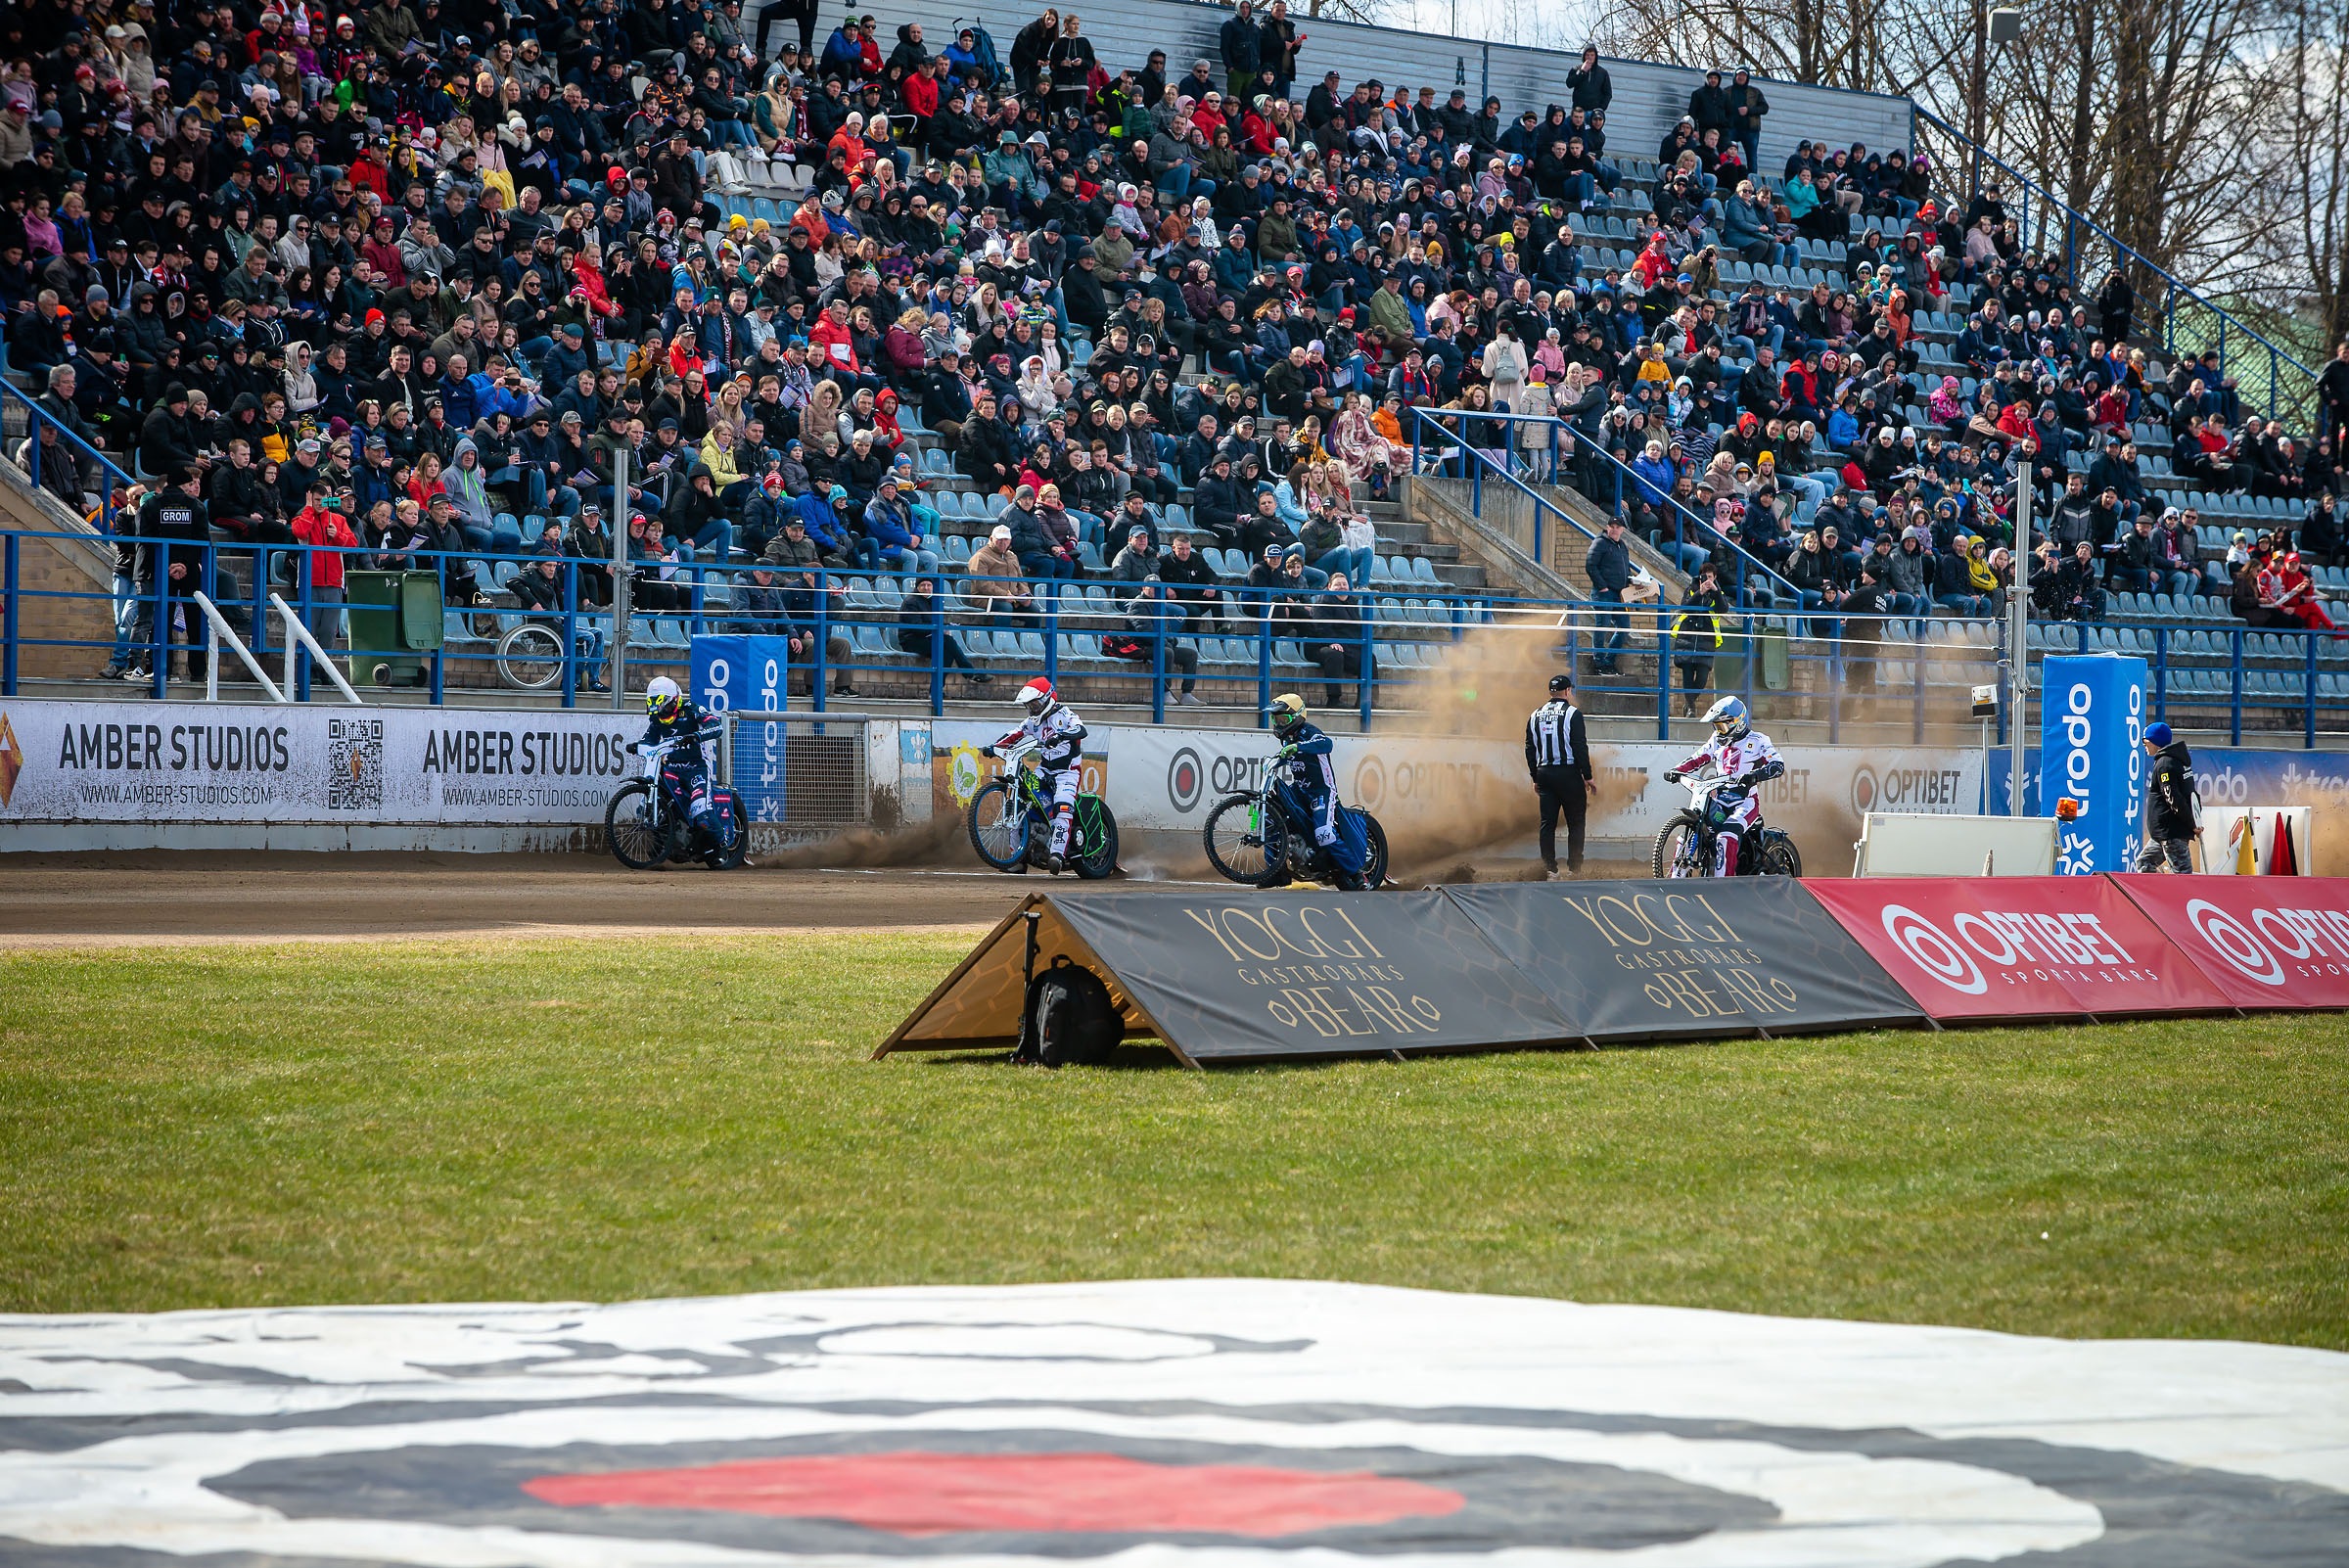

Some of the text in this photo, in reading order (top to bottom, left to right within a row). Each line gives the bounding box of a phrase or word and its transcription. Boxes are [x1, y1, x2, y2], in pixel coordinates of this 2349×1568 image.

[162, 511, 190, 522] GROM
[59, 723, 289, 772] AMBER STUDIOS
[422, 729, 625, 776] AMBER STUDIOS
[2125, 684, 2141, 826] trodo
[80, 785, 272, 806] WWW.AMBER-STUDIOS.COM
[442, 788, 610, 808] WWW.AMBER-STUDIOS.COM
[1884, 769, 1961, 805] OPTIBET
[1182, 906, 1386, 962] YOGGI
[1563, 894, 1745, 947] YOGGI
[1954, 910, 2137, 966] OPTIBET
[1238, 963, 1405, 986] GASTROBĀRS
[1615, 947, 1763, 970] GASTROBĀRS
[2001, 967, 2159, 985] SPORTA BĀRS
[1279, 987, 1440, 1038] BEAR
[1654, 968, 1797, 1018] BEAR
